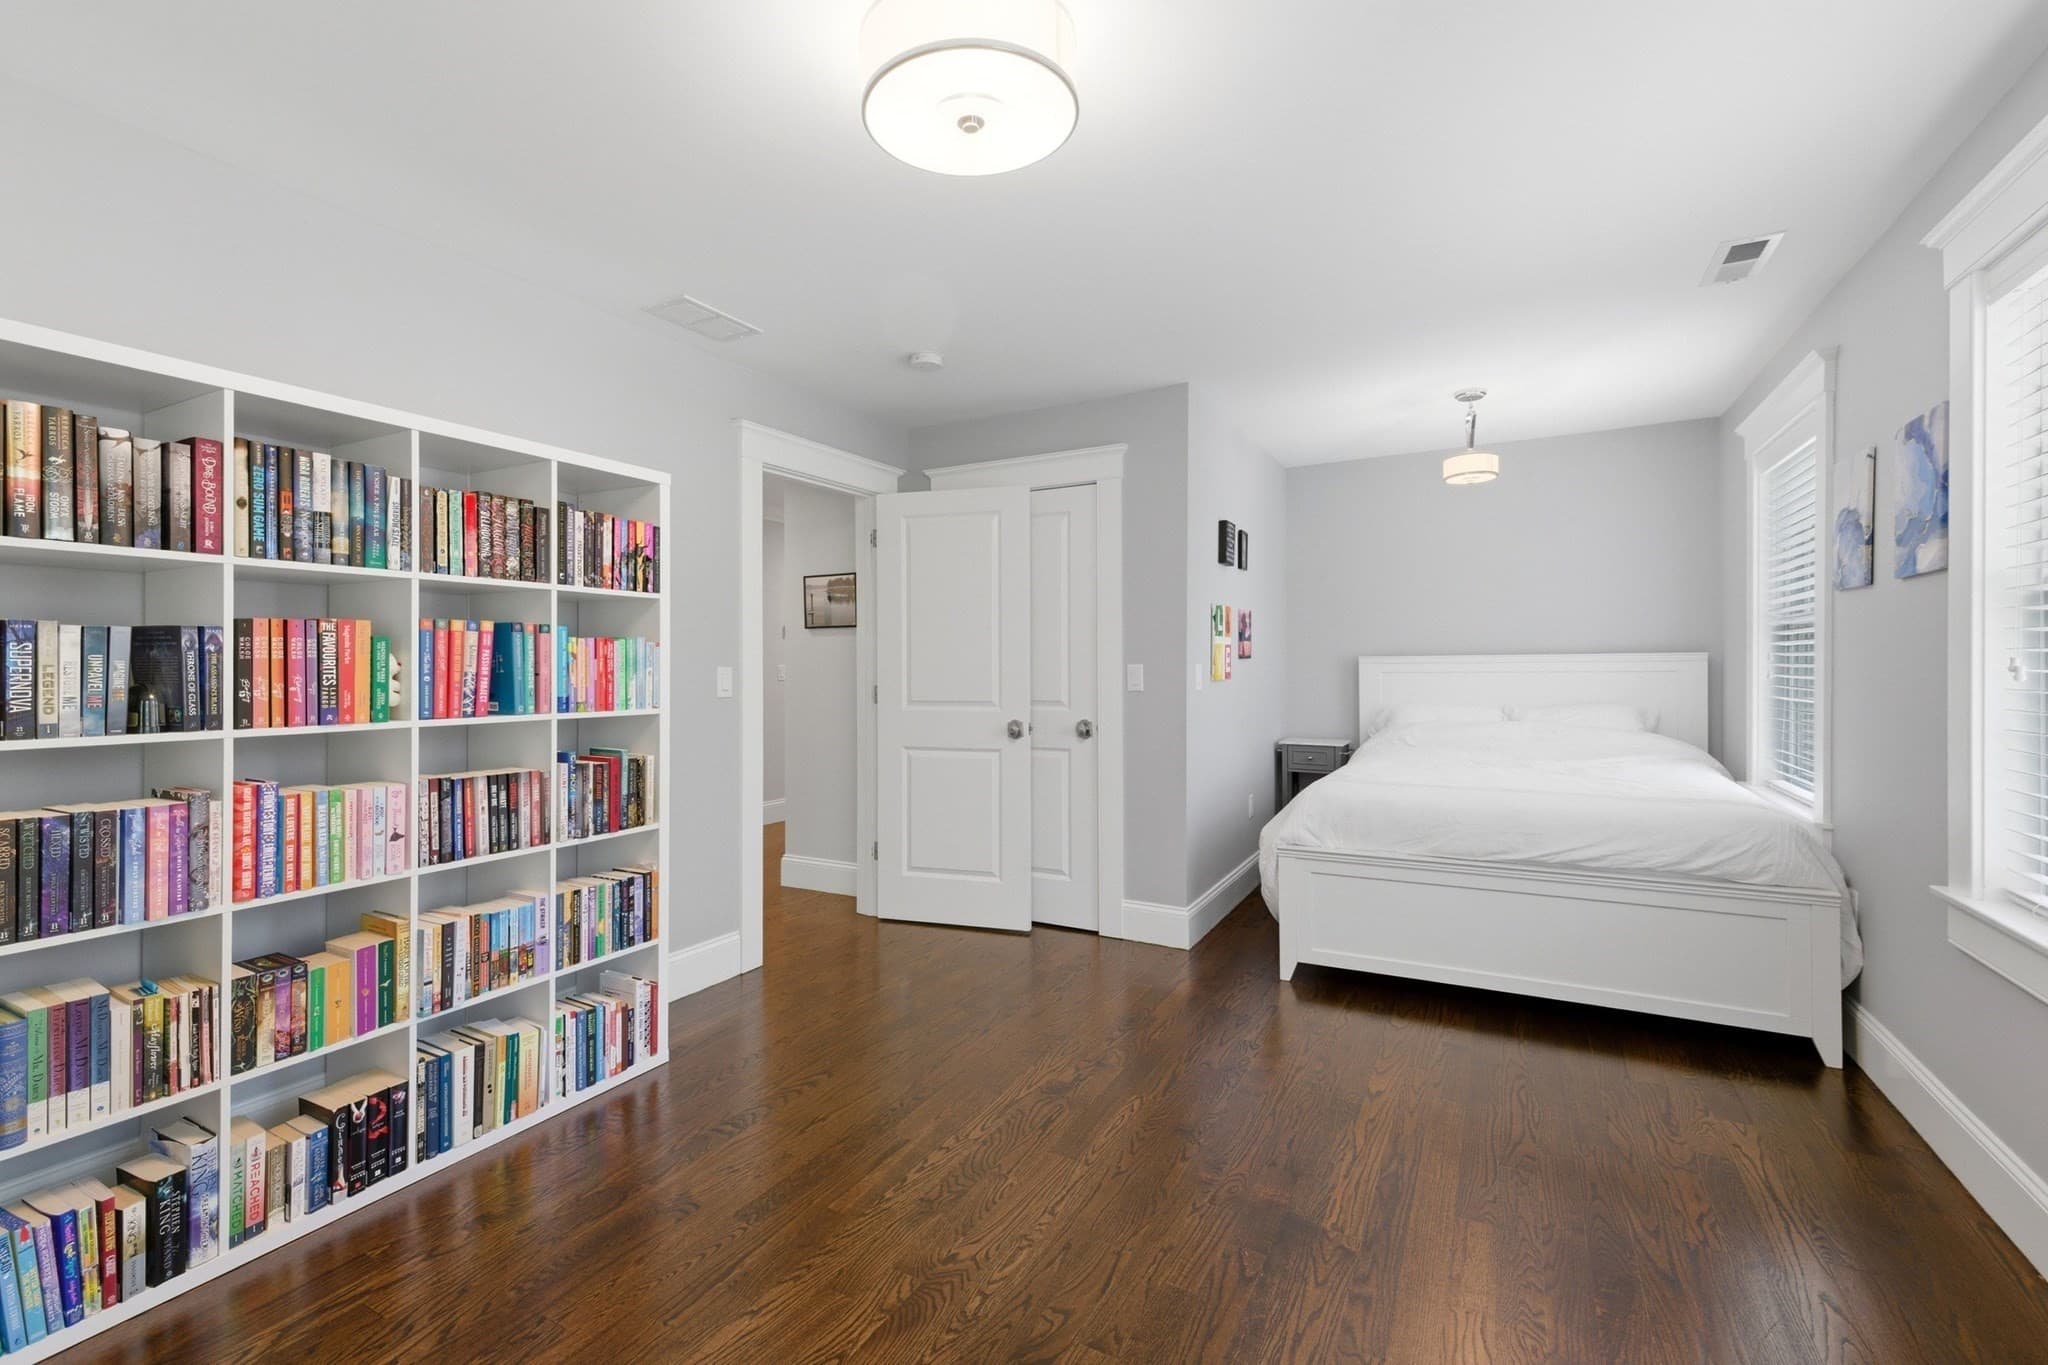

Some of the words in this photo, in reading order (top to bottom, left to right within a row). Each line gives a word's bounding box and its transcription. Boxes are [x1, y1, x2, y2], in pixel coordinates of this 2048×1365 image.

[253, 465, 265, 490] ZERO
[299, 455, 311, 475] NORA
[13, 487, 25, 518] FLAME
[25, 493, 35, 514] IRON
[49, 491, 60, 520] STORM
[60, 494, 70, 519] ONYX
[253, 492, 265, 513] SUM
[299, 475, 311, 507] ROBERTS
[253, 515, 265, 542] GAME
[320, 622, 337, 632] THE
[87, 654, 104, 693] UNRAVEL
[186, 650, 196, 681] THRONE
[322, 632, 337, 686] FAVOURITES
[8, 642, 32, 714] SUPERNOVA
[42, 664, 55, 716] LEGEND
[187, 681, 196, 692] OF
[63, 696, 77, 710] ME
[87, 695, 103, 709] ME
[188, 693, 197, 716] GLASS
[0, 827, 11, 870] SCARRED
[22, 822, 35, 870] WRETCHED
[78, 822, 90, 860] TWISTED
[98, 818, 112, 858] CROSSED
[146, 1023, 161, 1070] Mayflower
[191, 1151, 210, 1199] KING
[231, 1170, 244, 1230] MATCHED
[249, 1161, 262, 1222] REACHED
[159, 1199, 172, 1236] KING
[171, 1189, 181, 1234] STEPHEN
